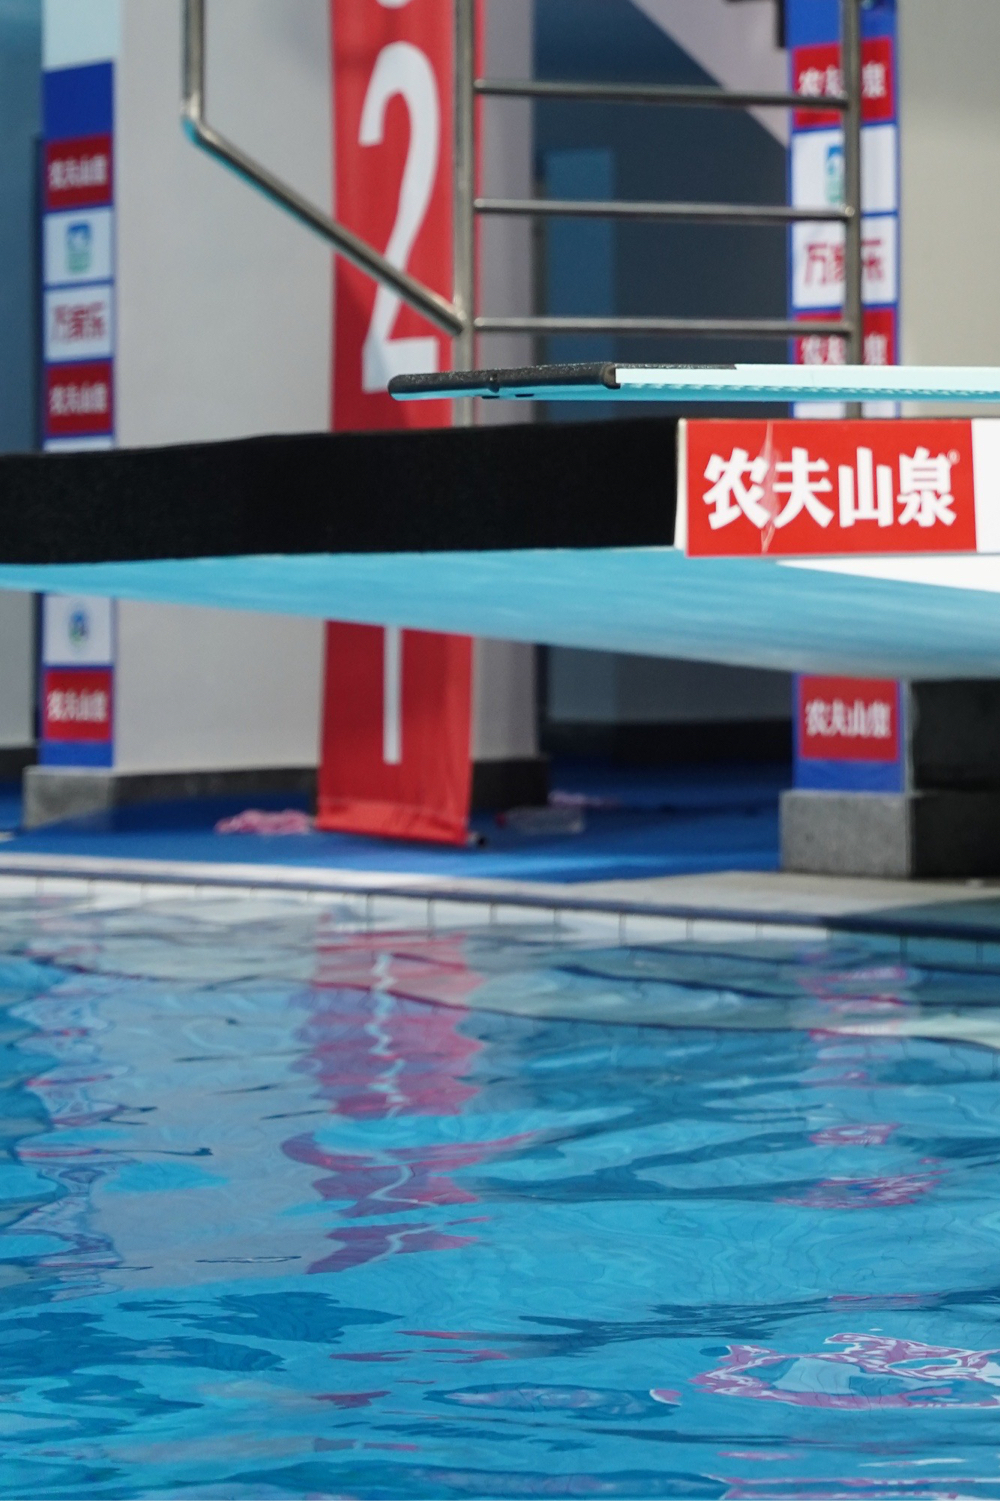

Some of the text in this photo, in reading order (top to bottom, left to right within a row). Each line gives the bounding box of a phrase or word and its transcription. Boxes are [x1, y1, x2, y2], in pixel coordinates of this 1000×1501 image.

[358, 41, 440, 393] 2
[702, 446, 957, 529] 农夫山泉
